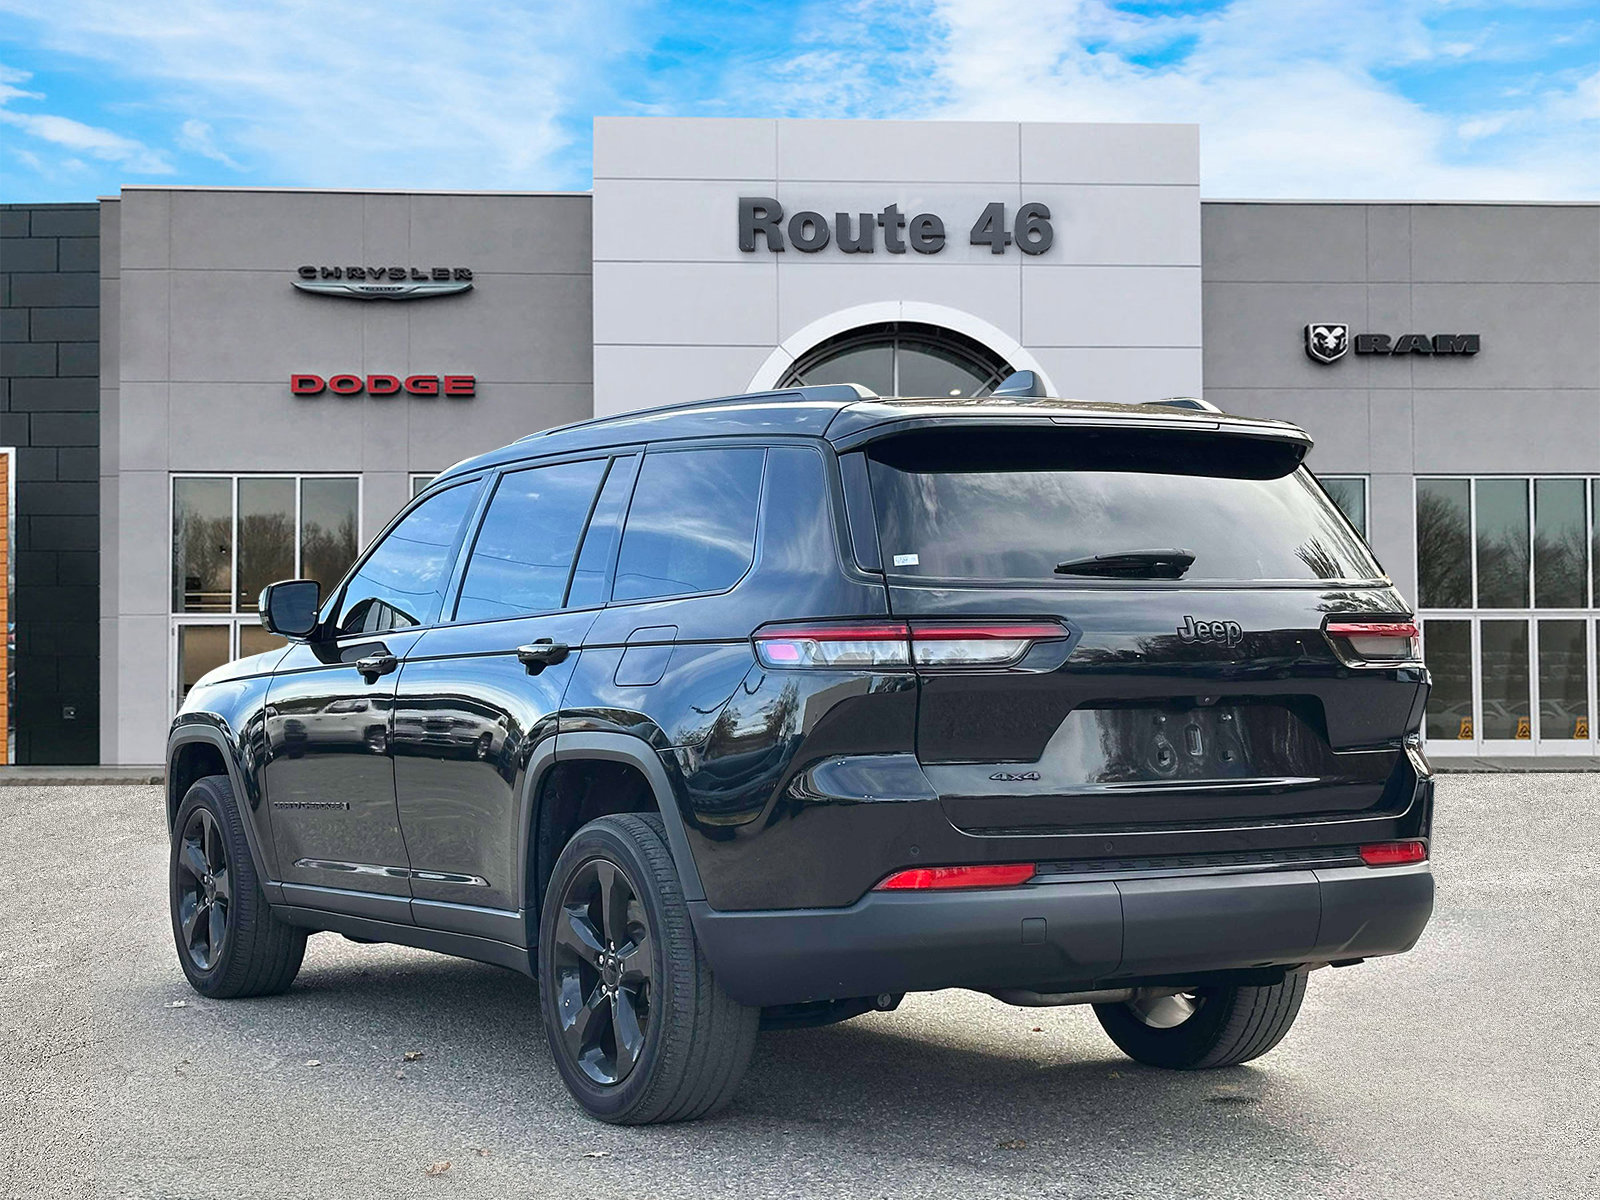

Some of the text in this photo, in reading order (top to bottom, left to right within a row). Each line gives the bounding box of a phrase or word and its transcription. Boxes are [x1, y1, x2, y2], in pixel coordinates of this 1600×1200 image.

[738, 197, 1054, 255] Route 46
[297, 265, 474, 281] CHRYSLER
[1354, 334, 1480, 355] RAM
[290, 374, 476, 396] DODGE
[1177, 615, 1243, 648] Jeep
